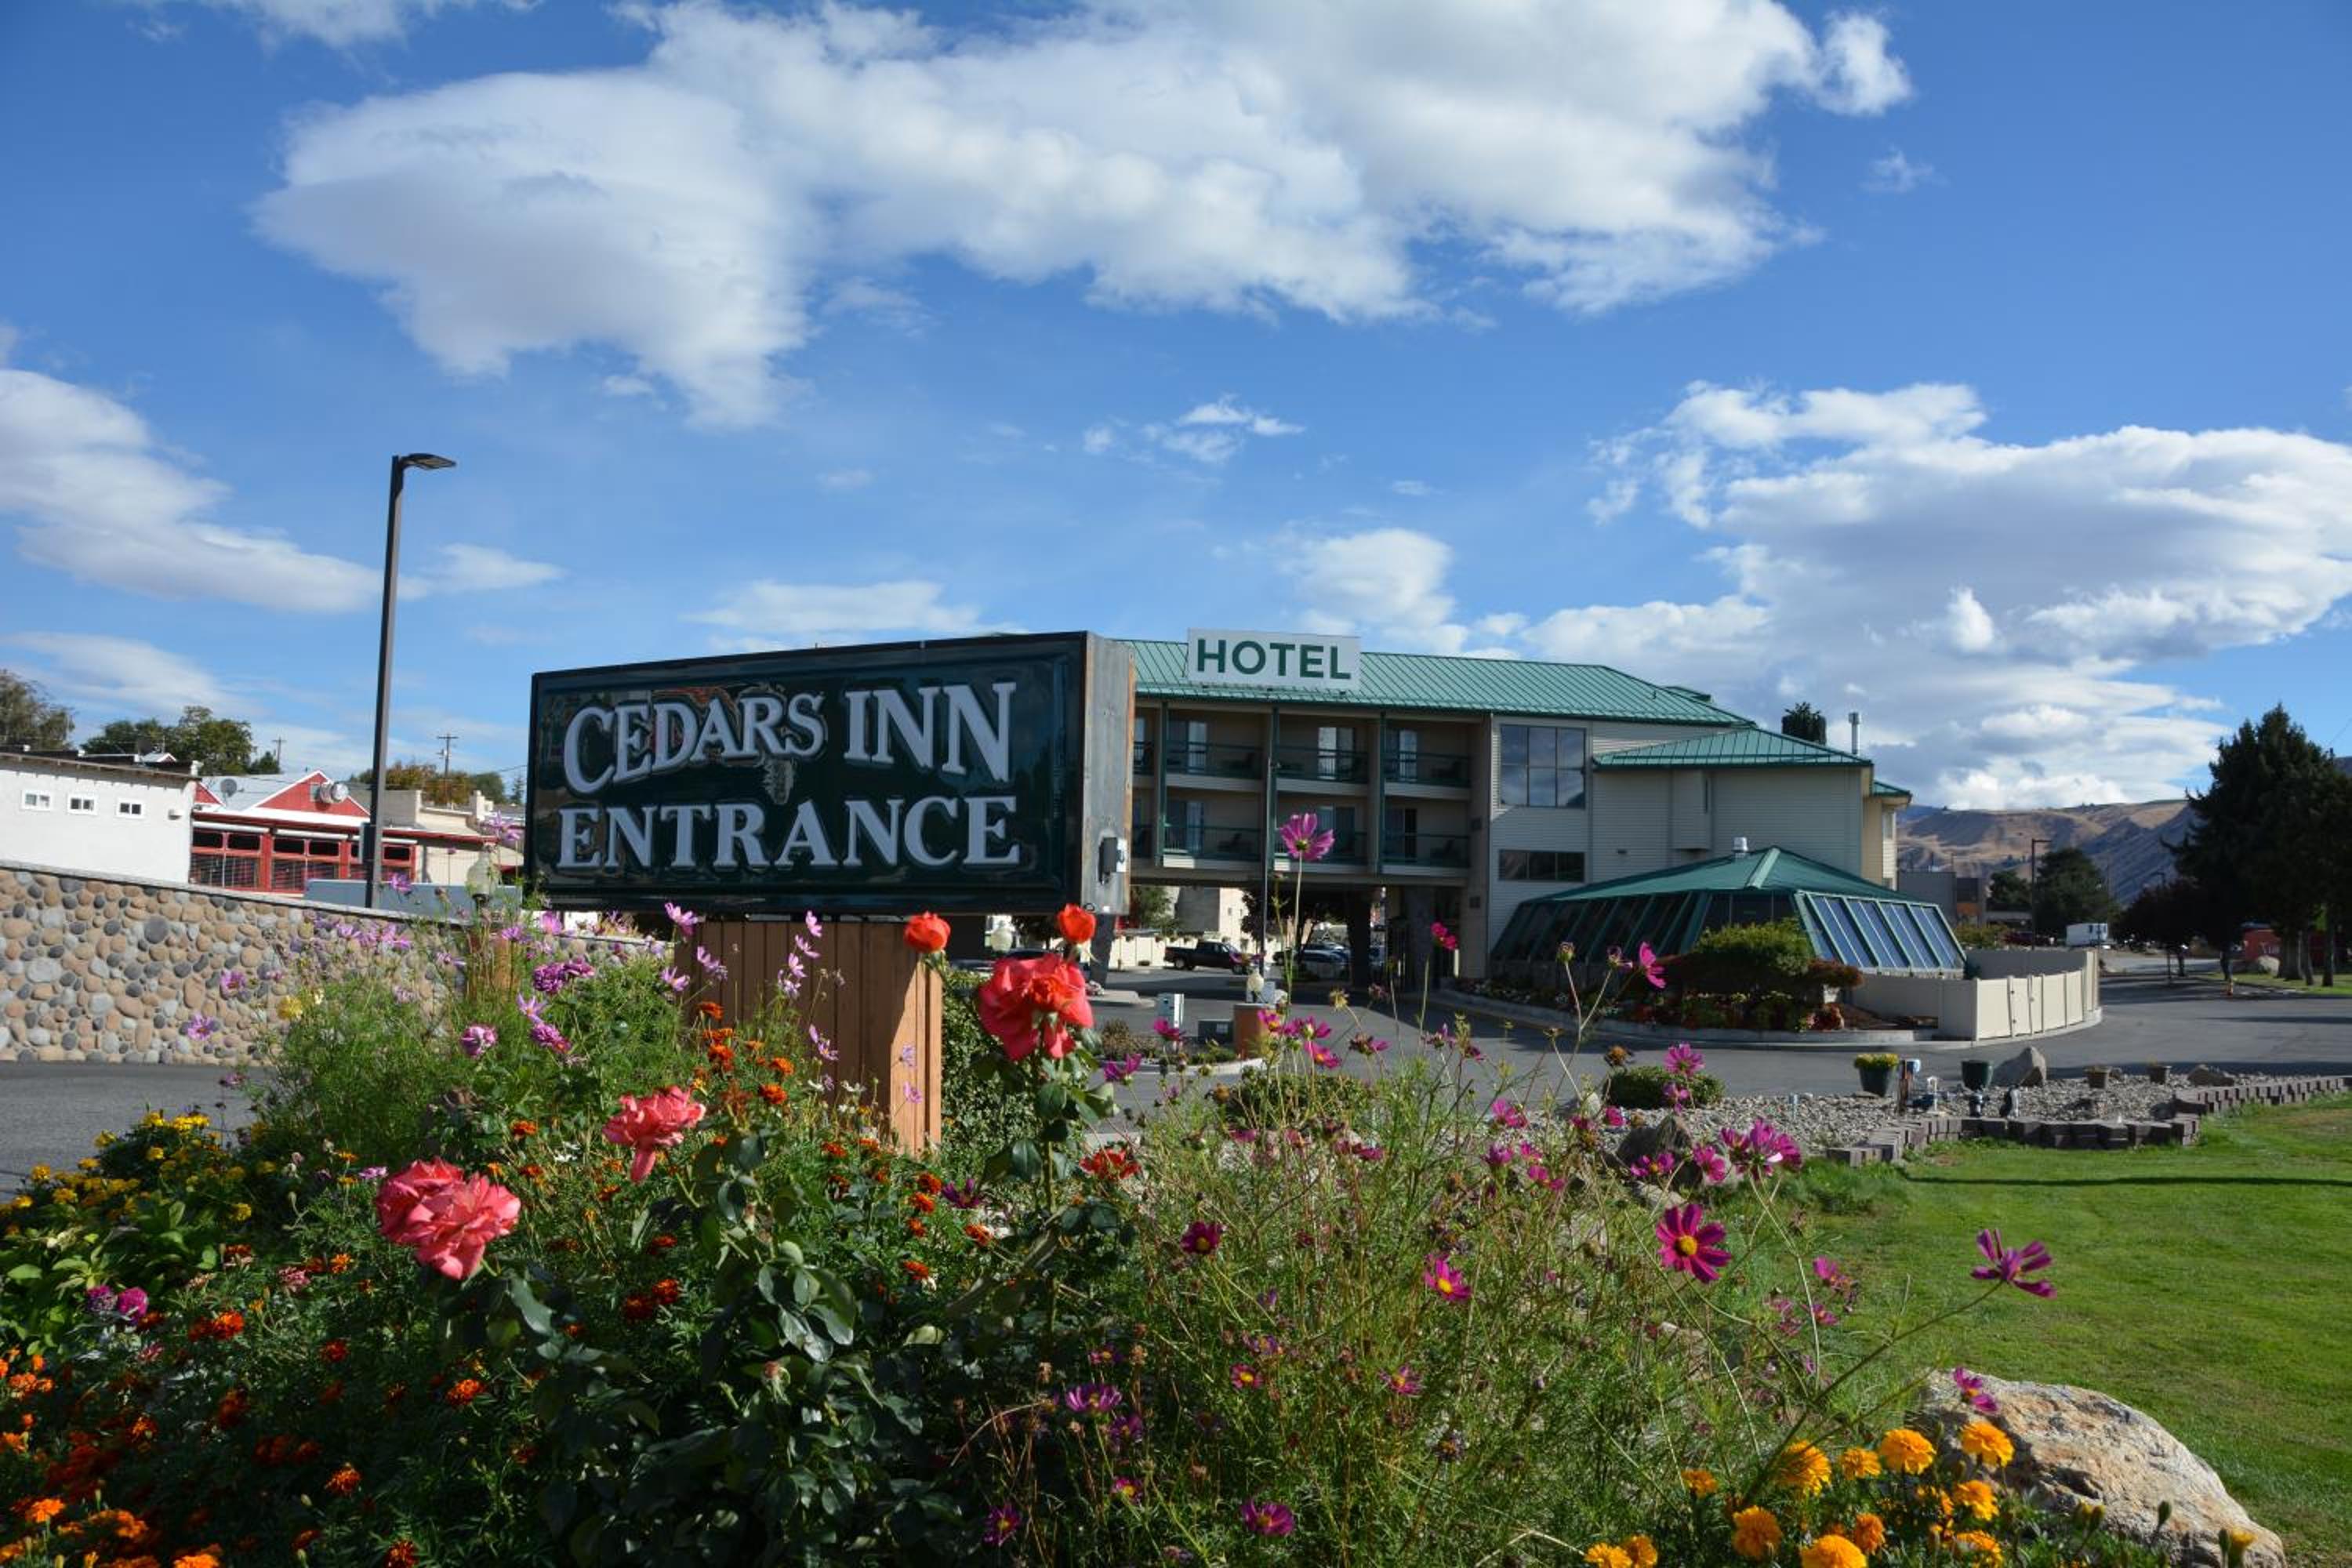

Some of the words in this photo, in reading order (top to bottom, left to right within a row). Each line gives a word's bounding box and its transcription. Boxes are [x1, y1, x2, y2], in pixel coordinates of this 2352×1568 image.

[1197, 638, 1351, 680] HOTEL
[564, 692, 825, 794] CEDARS
[844, 682, 1016, 782] INN
[558, 796, 1019, 868] ENTRANCE
